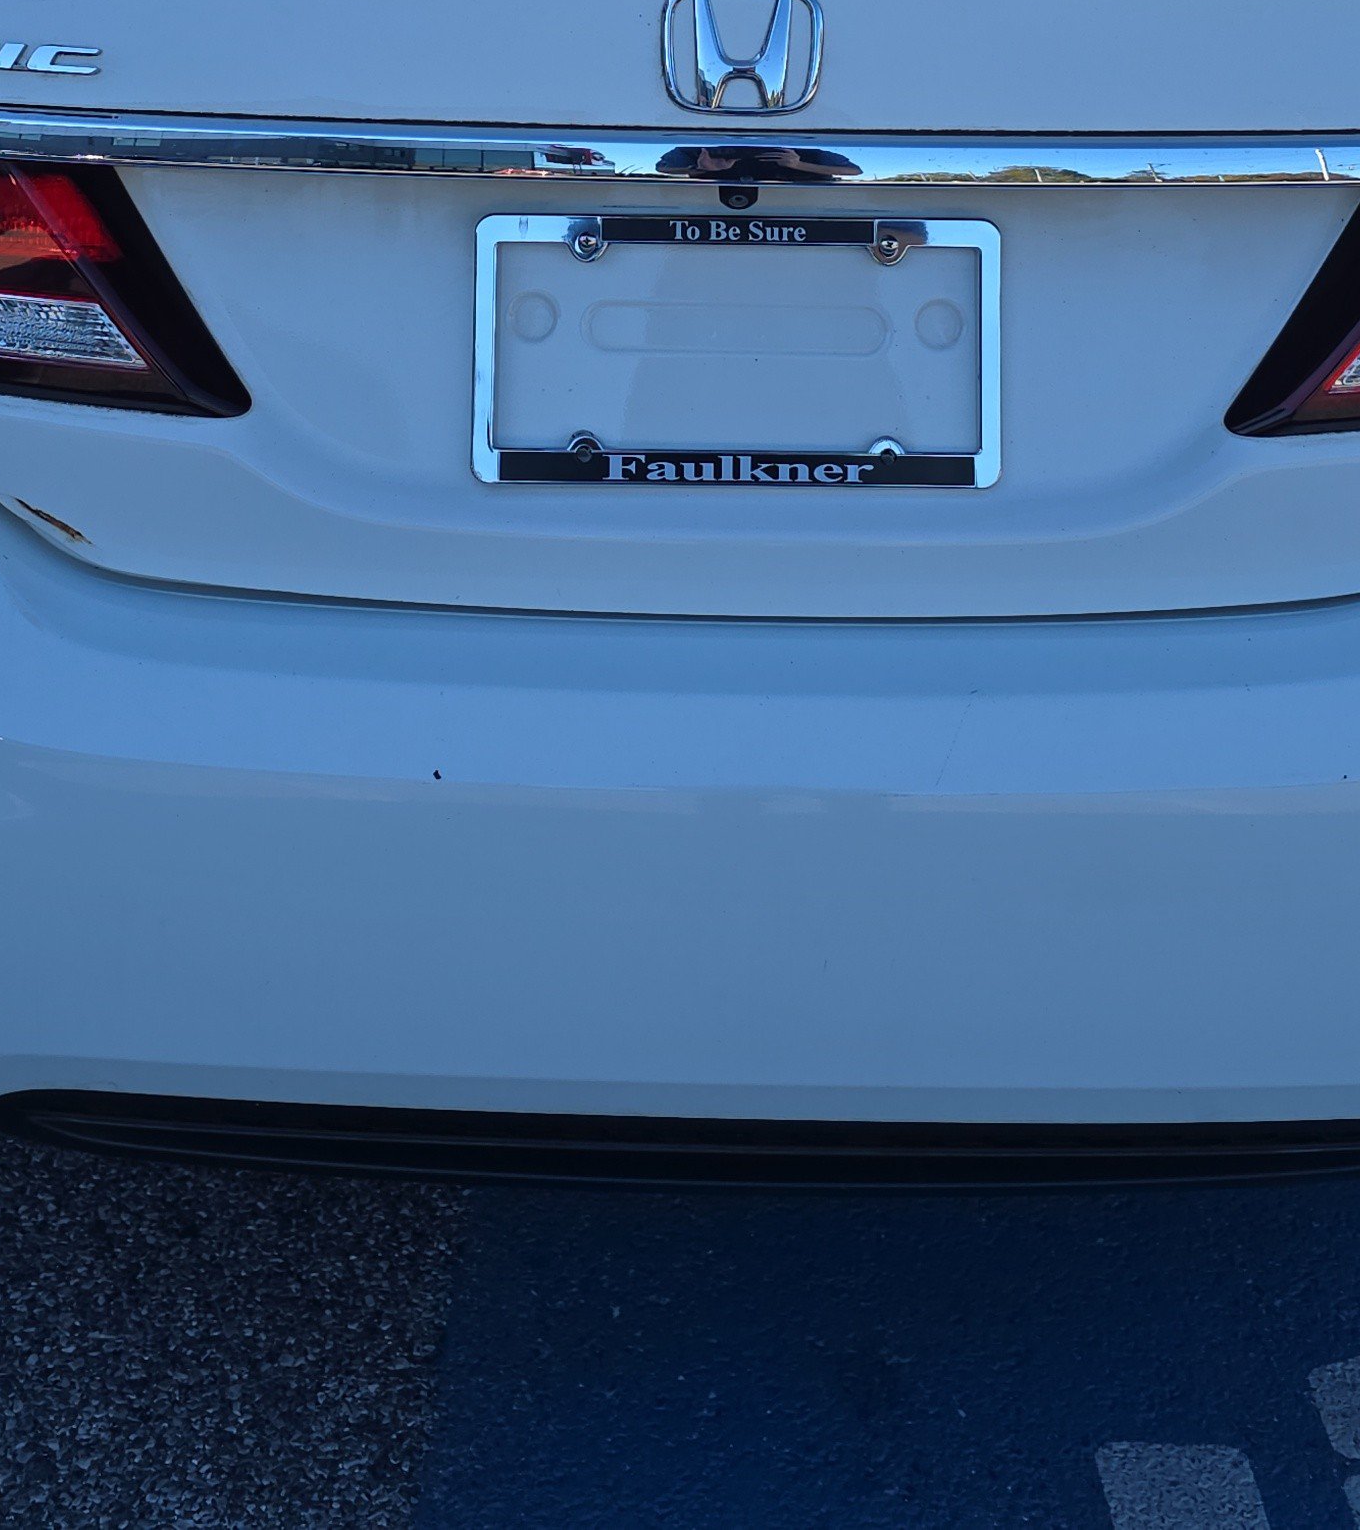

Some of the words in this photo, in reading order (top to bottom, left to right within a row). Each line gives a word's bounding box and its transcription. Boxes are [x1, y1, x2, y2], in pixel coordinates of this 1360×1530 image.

[669, 220, 700, 240] To
[709, 220, 740, 241] Be
[748, 221, 807, 241] Sure
[602, 454, 875, 483] Faulkner
